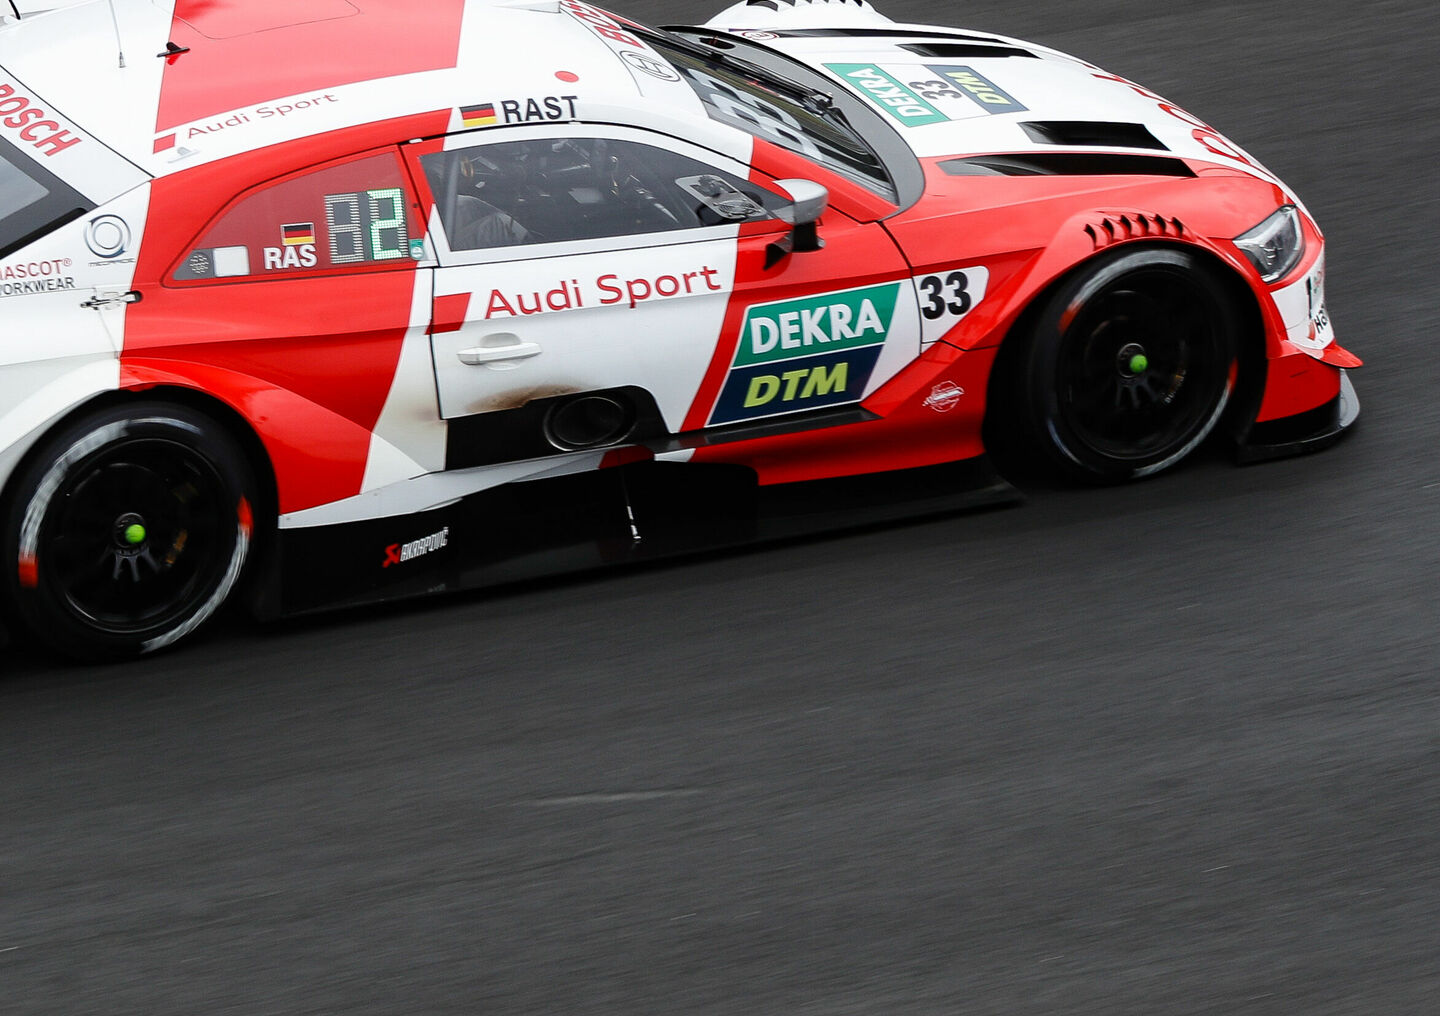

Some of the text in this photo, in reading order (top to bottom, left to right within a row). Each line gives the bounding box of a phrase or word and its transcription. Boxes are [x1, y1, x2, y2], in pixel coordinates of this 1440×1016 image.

[501, 95, 578, 124] RAST
[847, 68, 935, 117] DEKRA
[908, 80, 963, 100] 33
[944, 71, 1012, 105] DTM
[187, 93, 339, 139] Audi Sport
[263, 245, 318, 270] RAS
[485, 265, 722, 319] Audi Sport
[920, 271, 972, 321] 33
[750, 299, 886, 356] DEKRA
[743, 361, 849, 410] DTM
